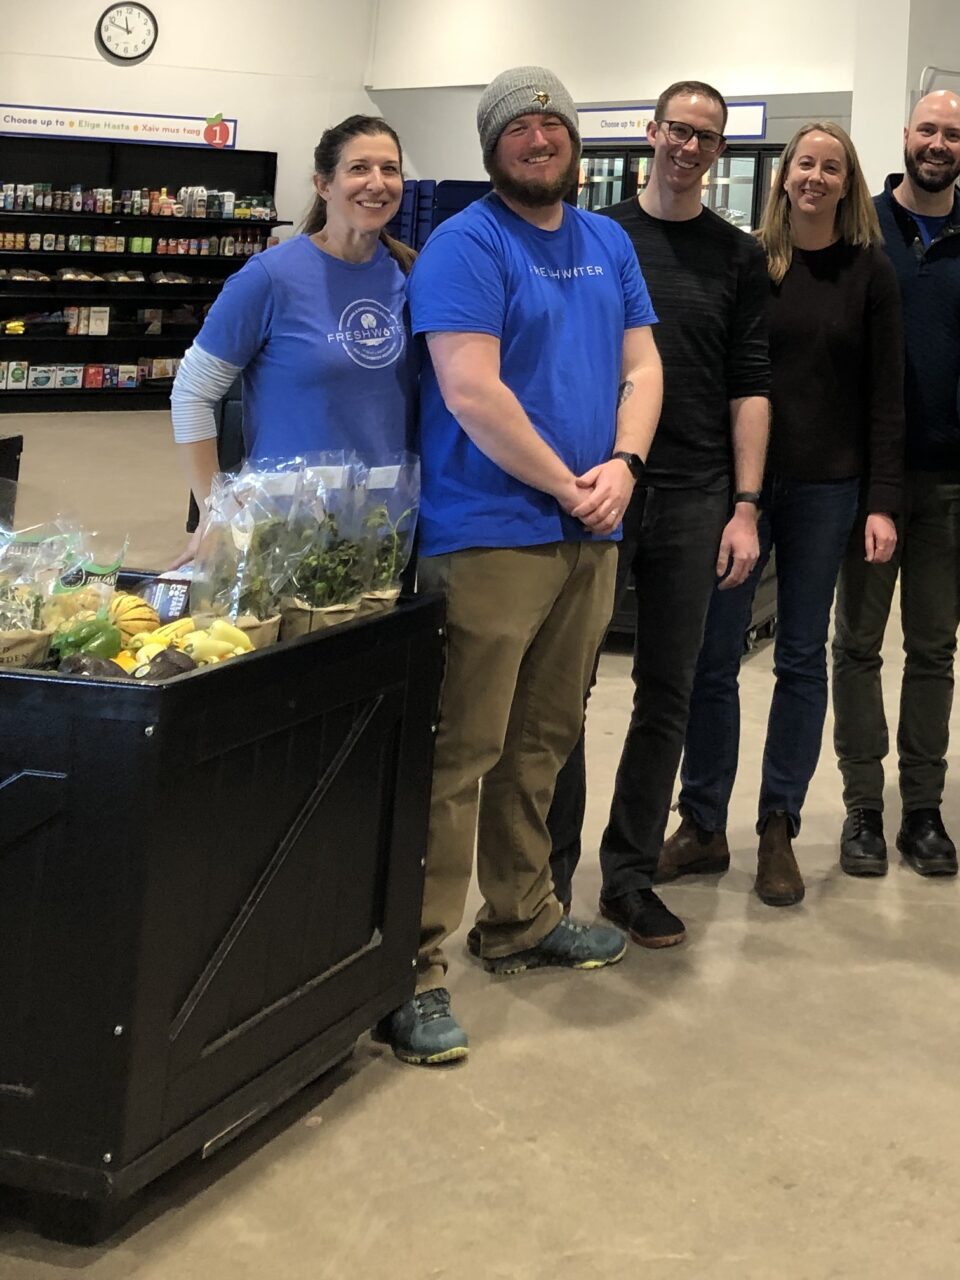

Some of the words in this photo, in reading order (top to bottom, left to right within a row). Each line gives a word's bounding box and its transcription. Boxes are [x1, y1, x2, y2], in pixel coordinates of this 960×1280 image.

[3, 114, 38, 125] Choose
[41, 119, 52, 127] up
[55, 118, 65, 127] to
[78, 119, 101, 129] Elige
[104, 121, 130, 130] Hasta
[142, 124, 160, 133] Xaiv
[162, 126, 180, 134] mus
[601, 120, 620, 128] Choose
[621, 121, 628, 129] up
[629, 120, 635, 128] to
[327, 325, 404, 344] FRESHWATE
